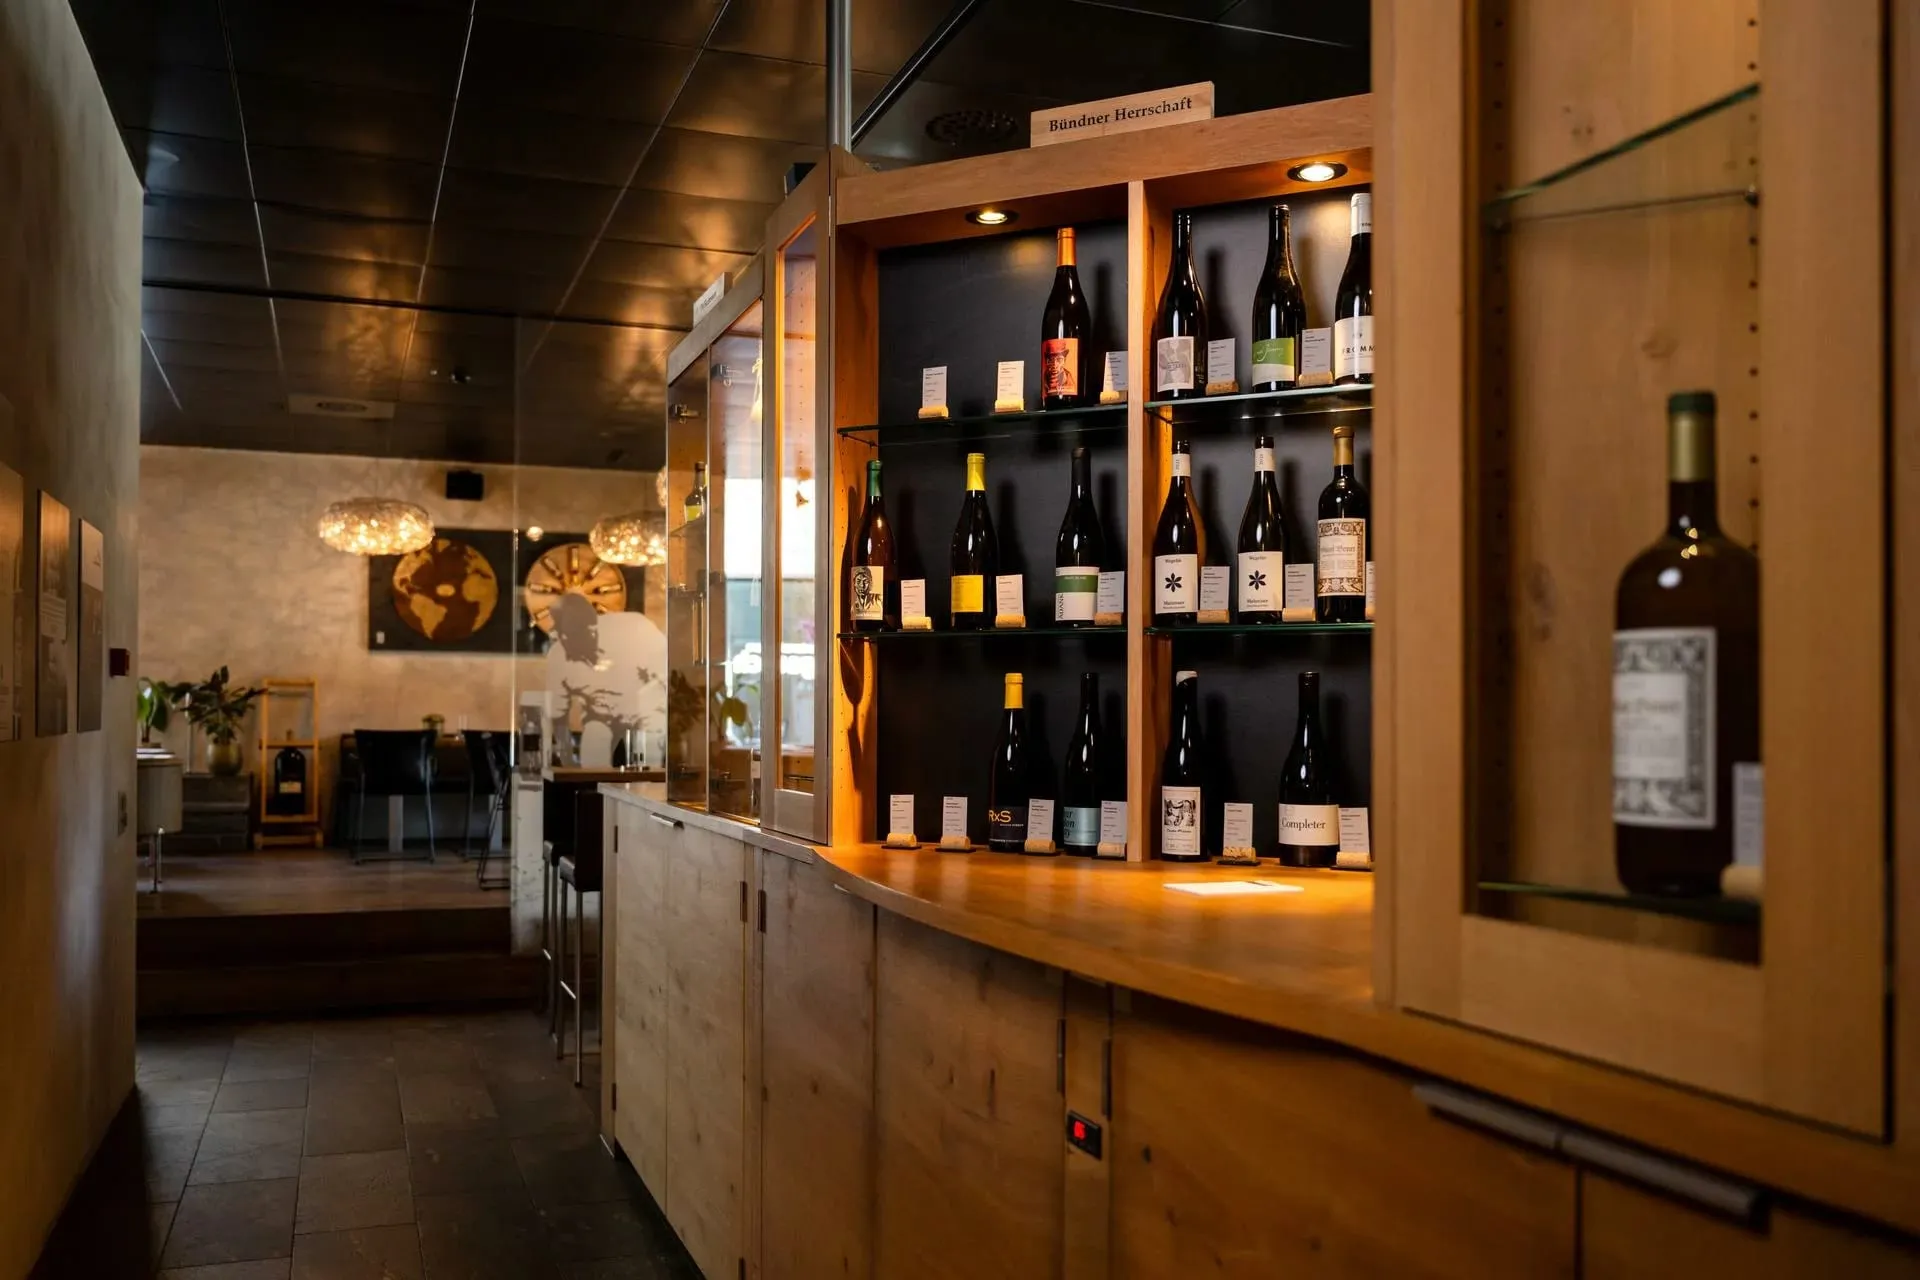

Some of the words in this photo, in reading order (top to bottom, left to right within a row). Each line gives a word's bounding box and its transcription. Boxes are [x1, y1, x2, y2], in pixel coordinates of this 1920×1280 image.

[1049, 113, 1110, 132] Bündner
[1114, 97, 1192, 121] Herrschaft
[988, 809, 1012, 823] RxS
[1281, 817, 1326, 831] Completer
